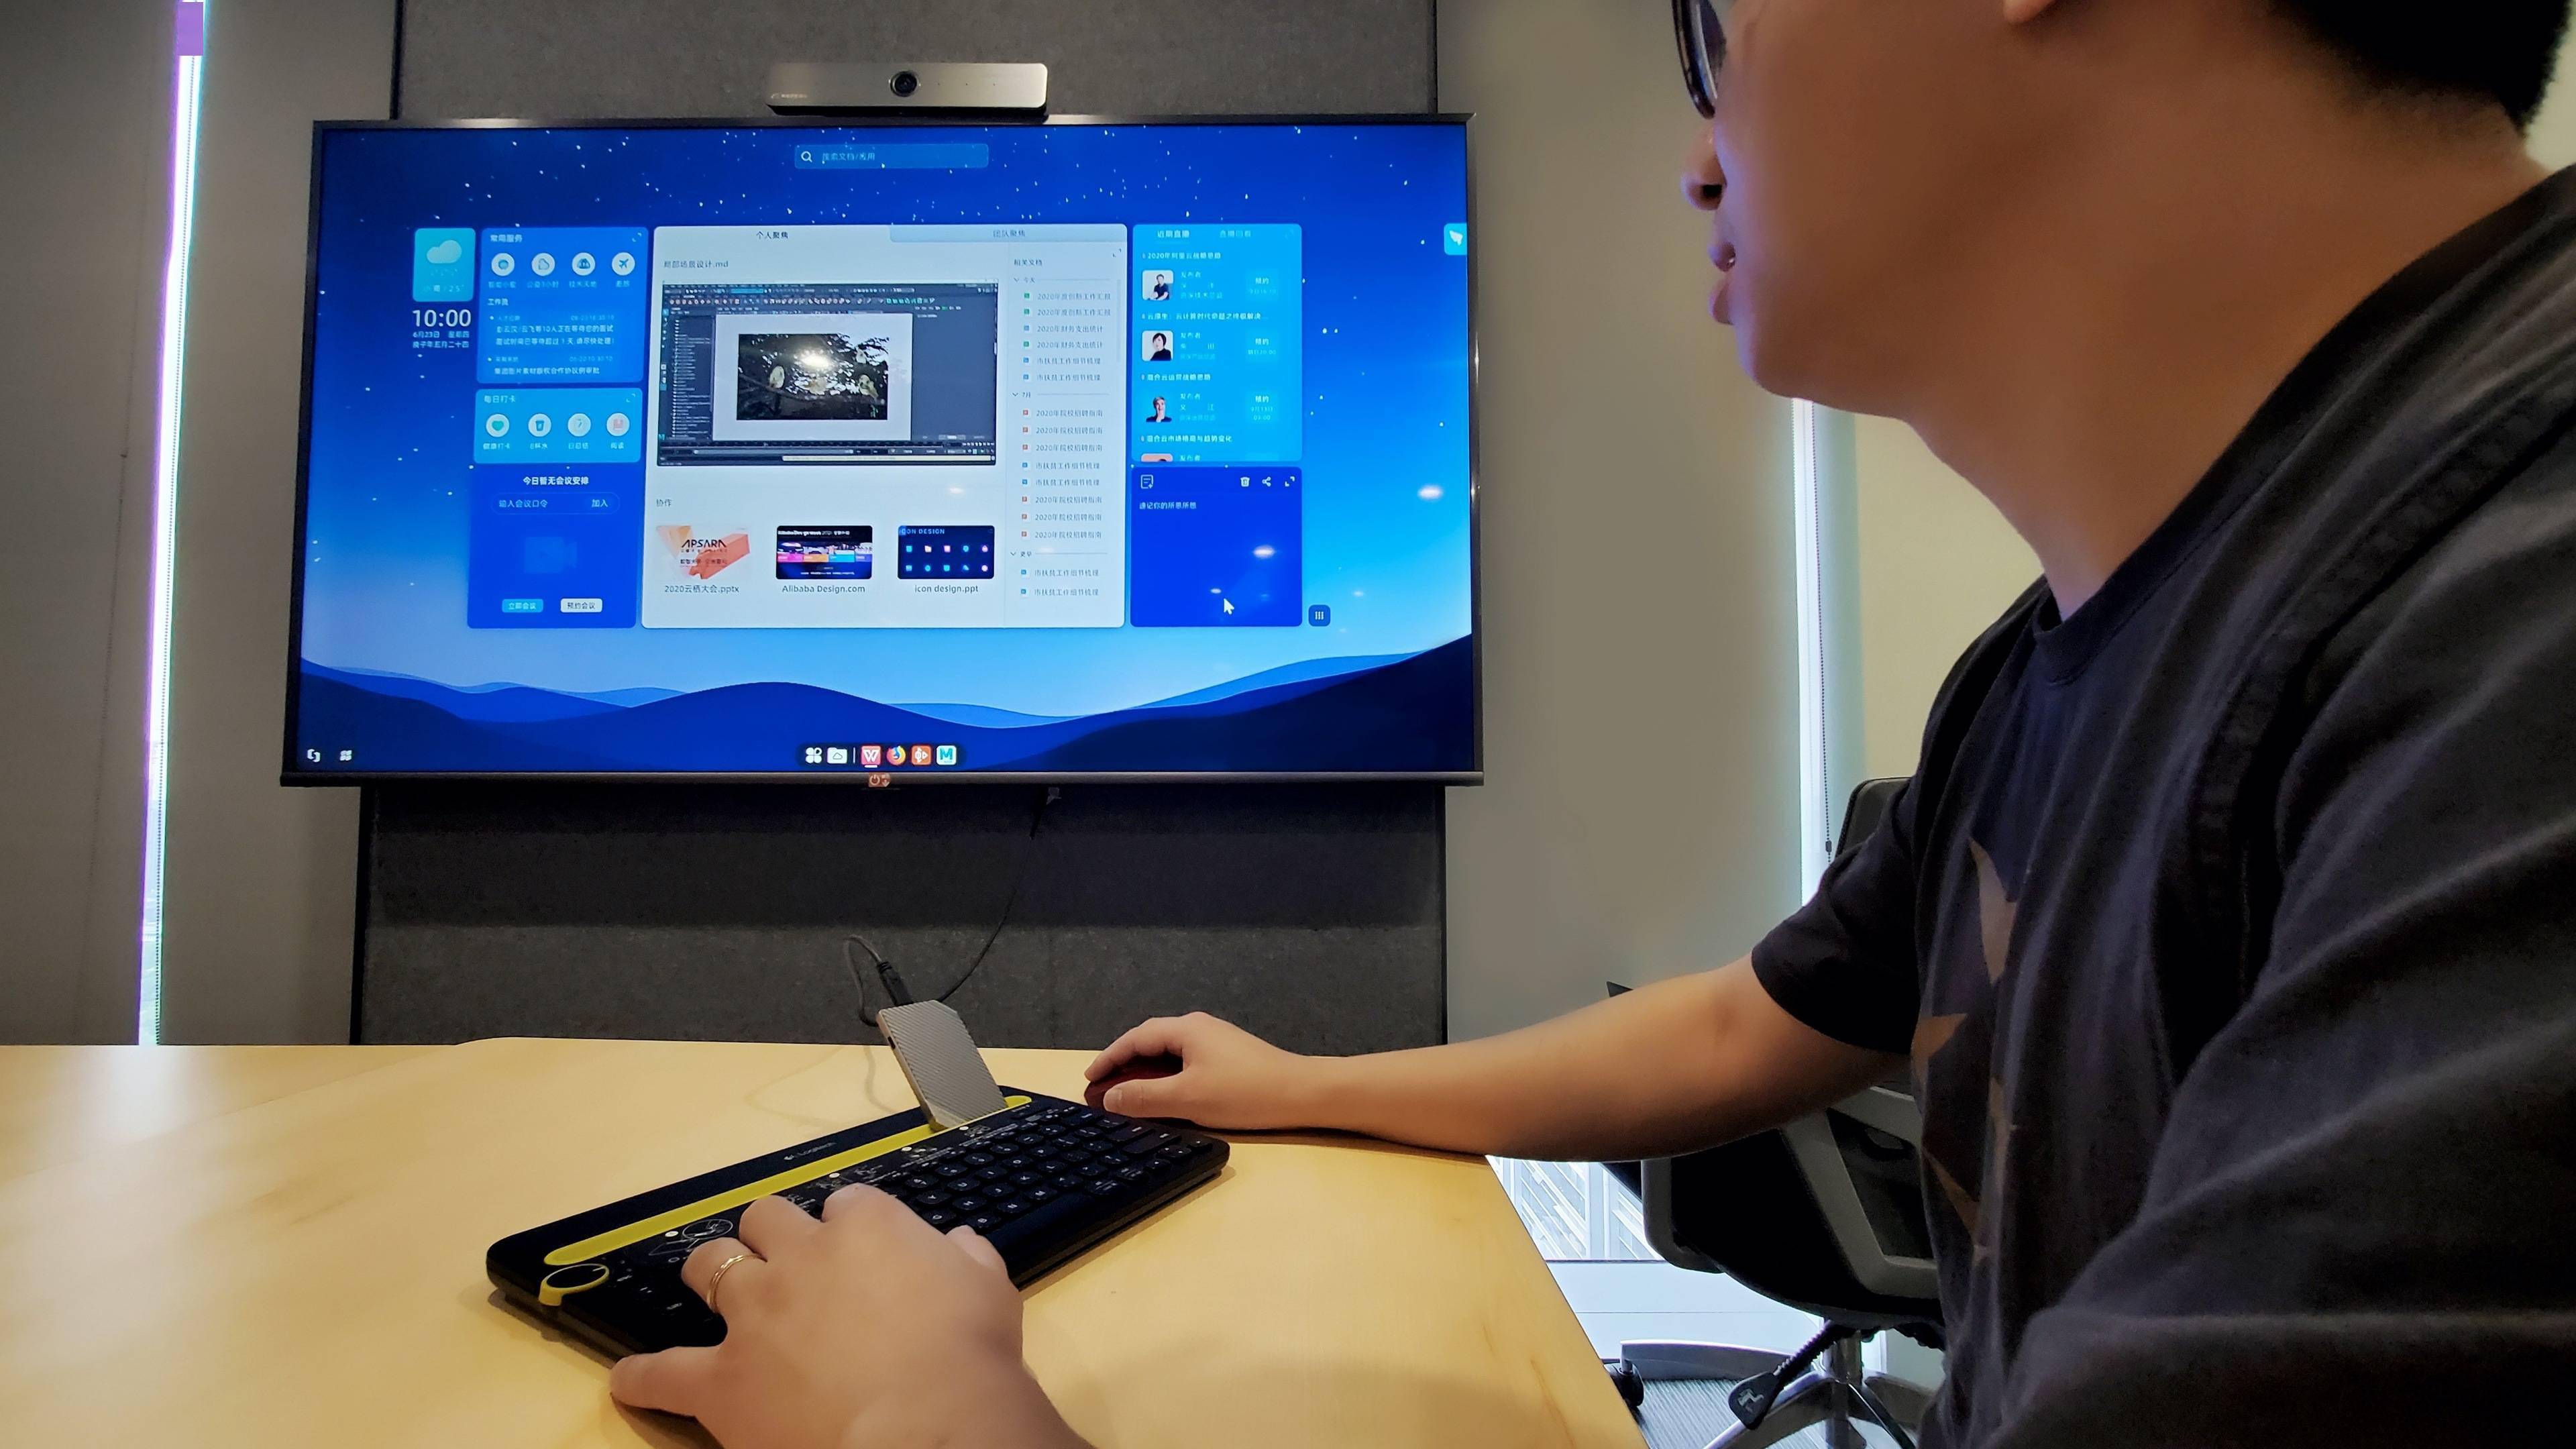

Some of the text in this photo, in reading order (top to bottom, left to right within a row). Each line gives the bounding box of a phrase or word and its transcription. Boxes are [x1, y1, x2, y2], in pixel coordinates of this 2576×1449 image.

[756, 231, 788, 239] 个人聚焦
[412, 309, 472, 327] 10:00
[523, 476, 589, 485] 今日暂无会议安排
[499, 499, 548, 508] 输入会议口令
[592, 499, 608, 508] 加入
[682, 539, 727, 548] APSARA
[665, 584, 739, 594] 2020云栖大会.pptx
[782, 585, 865, 594] Alibaba Design.com
[914, 585, 979, 594] icon design.ppt
